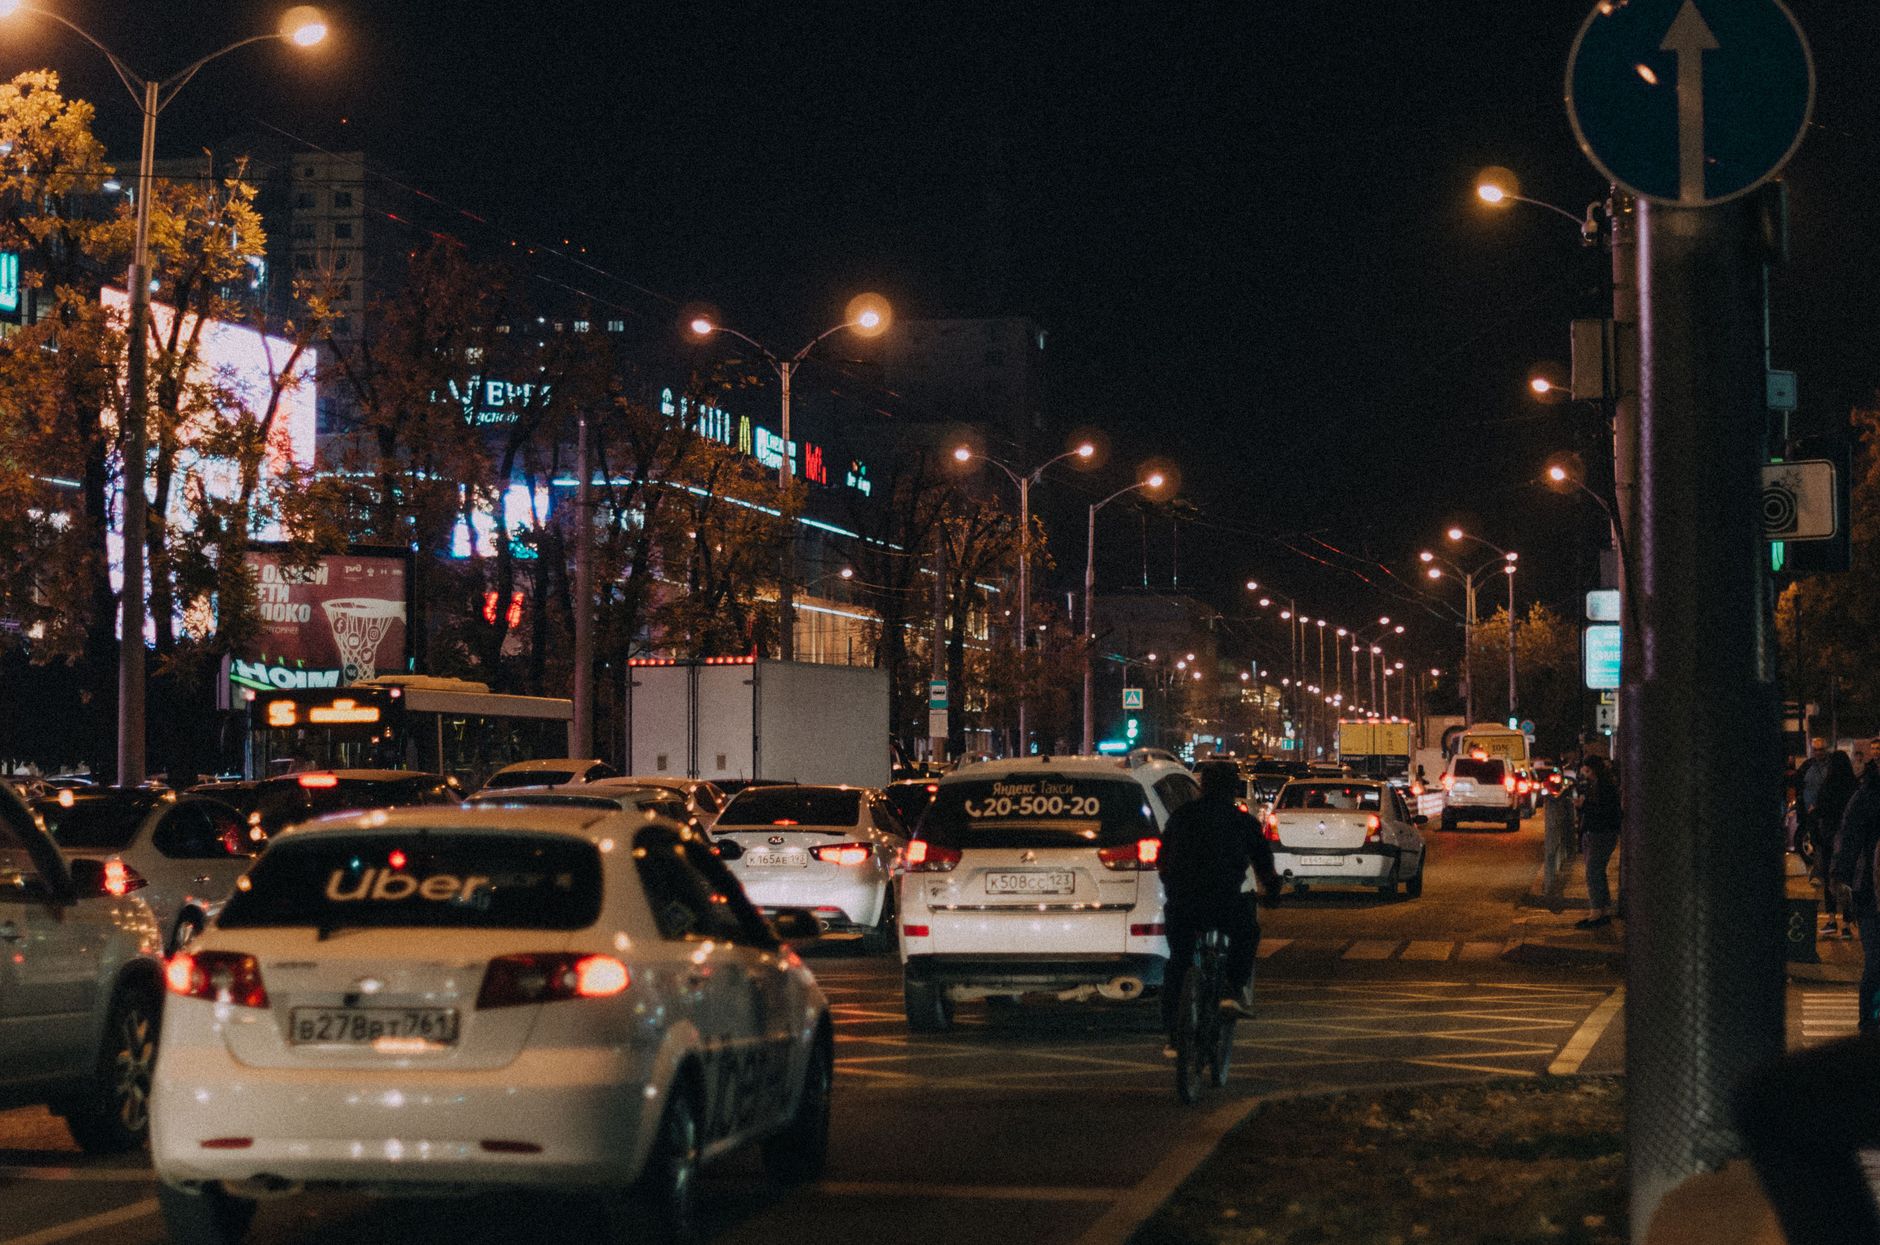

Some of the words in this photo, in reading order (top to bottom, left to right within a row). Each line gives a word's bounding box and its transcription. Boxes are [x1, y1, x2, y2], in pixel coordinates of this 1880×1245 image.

[993, 782, 1036, 795] Яндекс
[1040, 781, 1074, 794] Такси
[983, 796, 1100, 816] 20-500-20
[324, 868, 491, 902] Uber
